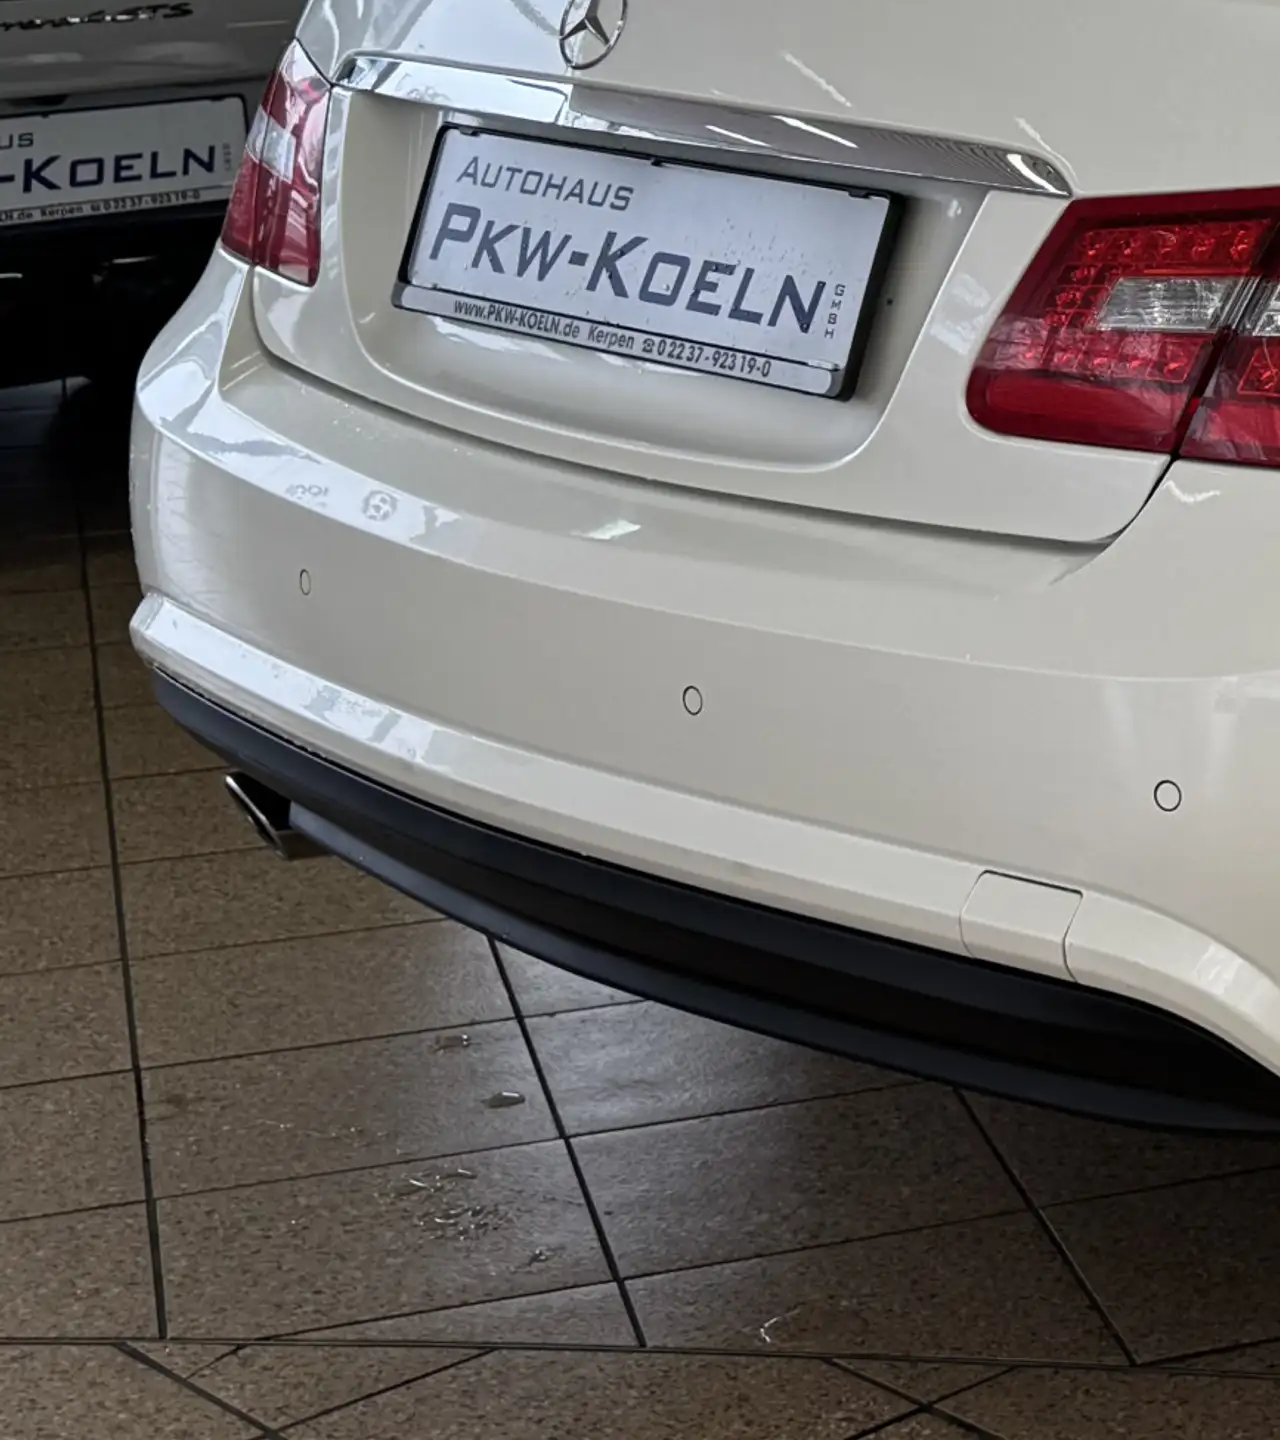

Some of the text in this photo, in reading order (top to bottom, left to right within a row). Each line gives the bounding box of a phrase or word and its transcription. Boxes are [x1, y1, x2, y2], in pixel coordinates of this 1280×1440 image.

[456, 156, 635, 212] AUTOHAUS
[429, 201, 827, 334] PKW-KOELN
[453, 299, 580, 339] www.PKW-KOELN.de
[587, 325, 635, 351] Kerpen
